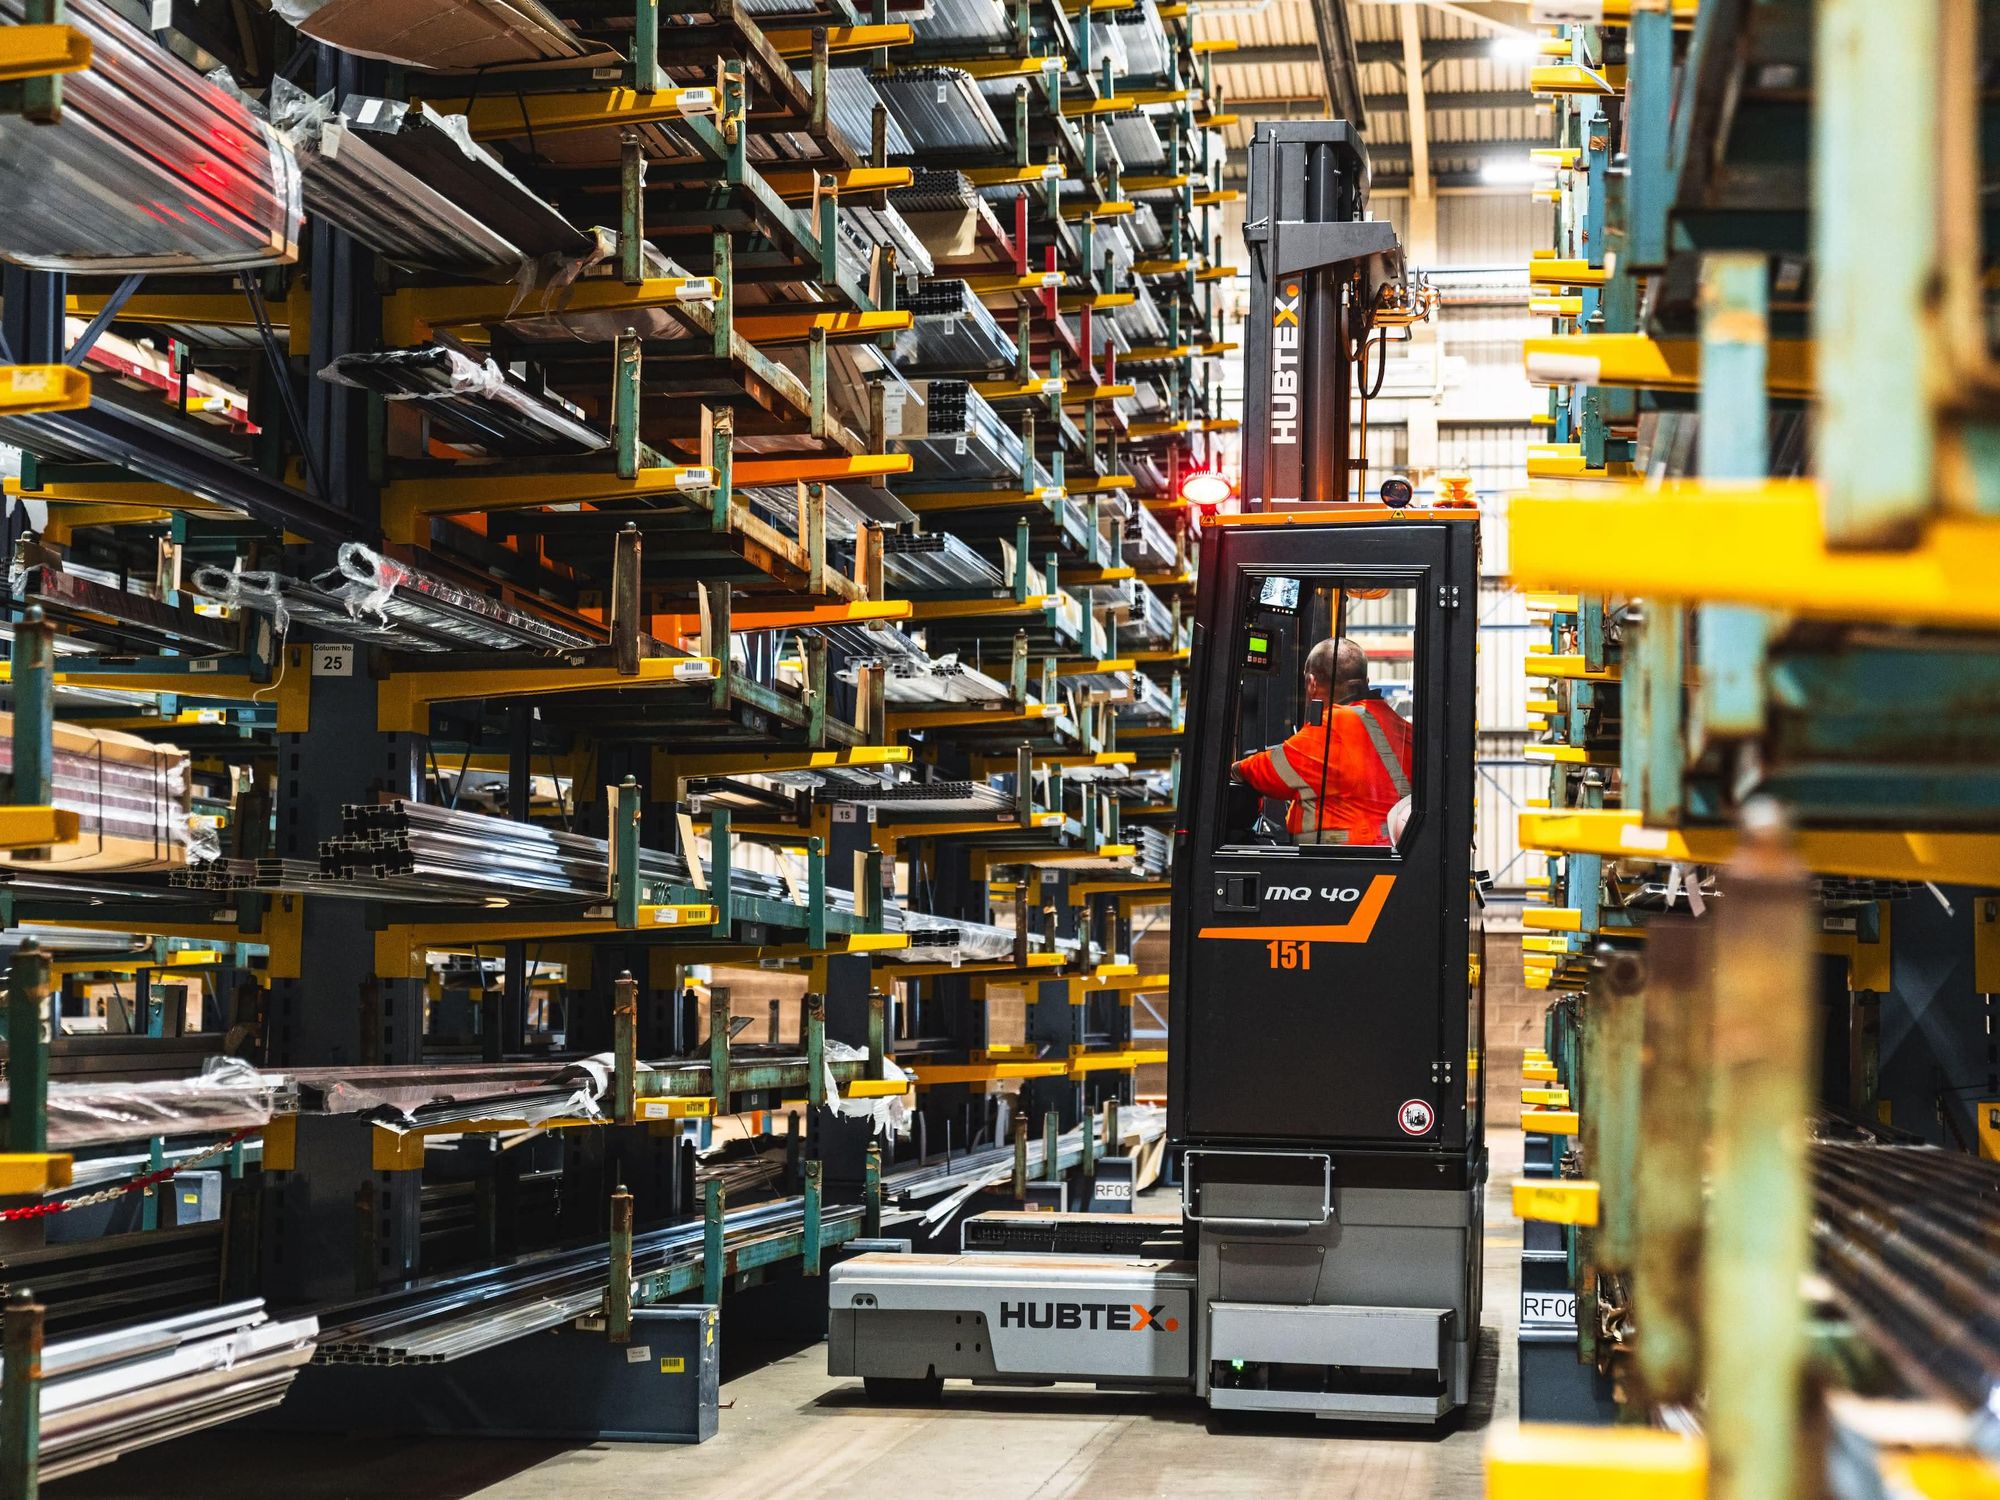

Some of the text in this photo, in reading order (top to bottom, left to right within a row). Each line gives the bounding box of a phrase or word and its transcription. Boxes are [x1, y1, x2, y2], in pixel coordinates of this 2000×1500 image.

[314, 644, 340, 652] Column
[323, 656, 343, 670] 25
[840, 810, 851, 820] 15
[1320, 887, 1360, 902] 40
[1266, 940, 1310, 970] 151
[1095, 1184, 1132, 1197] RF03
